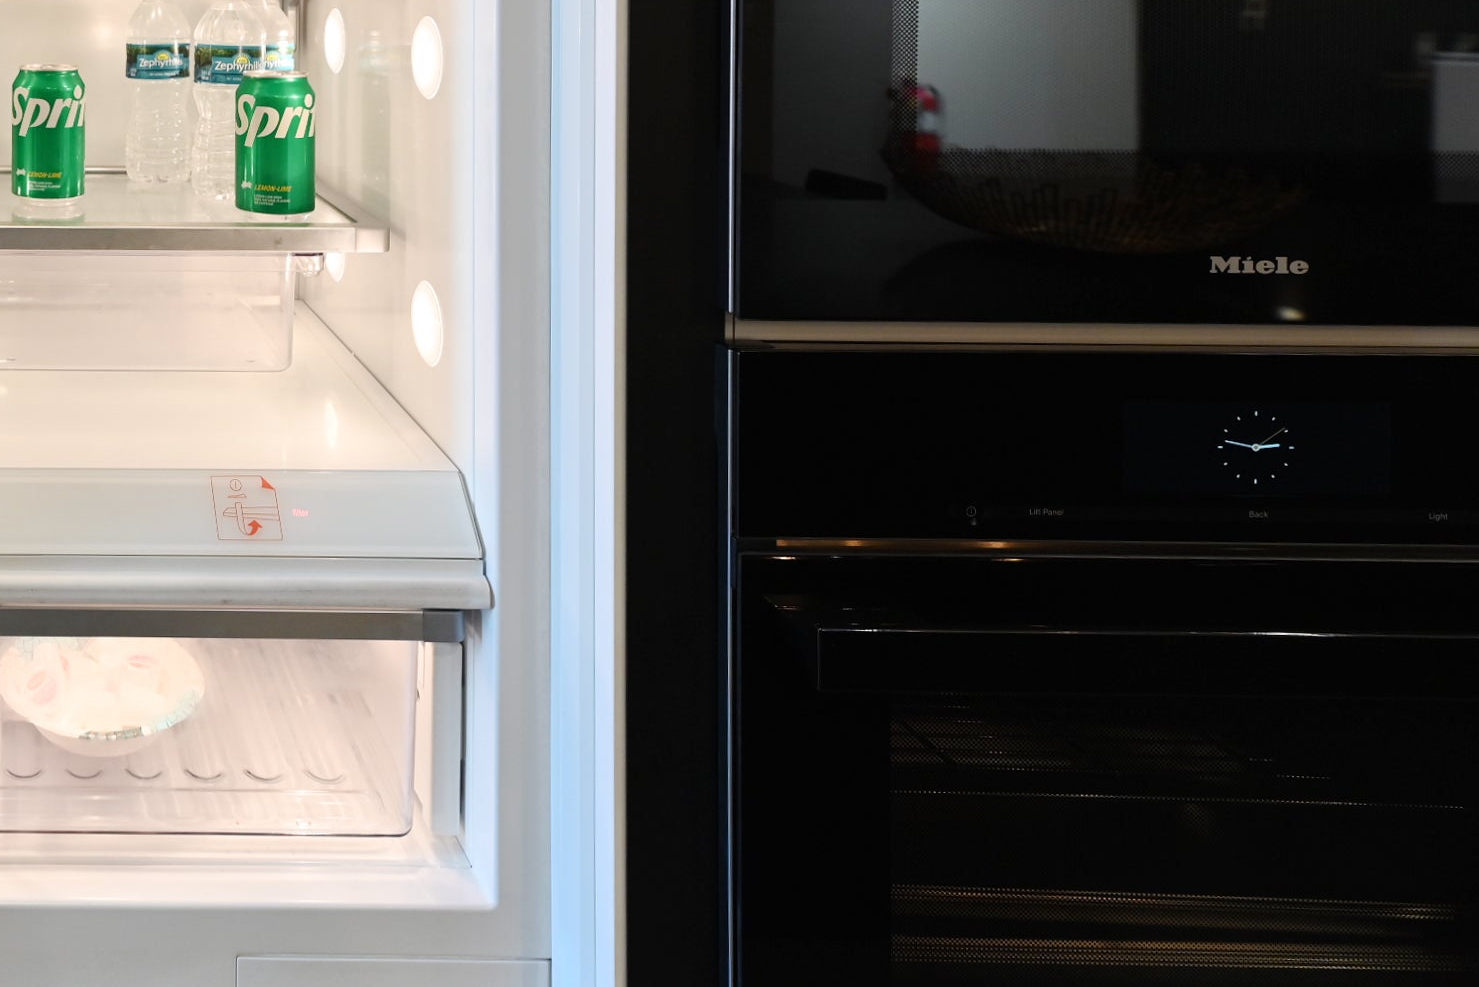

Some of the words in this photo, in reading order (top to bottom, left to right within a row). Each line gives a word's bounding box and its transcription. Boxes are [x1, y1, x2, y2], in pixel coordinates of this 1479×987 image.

[1209, 255, 1310, 275] Miele
[1248, 510, 1268, 518] Back
[1428, 511, 1448, 522] Light
